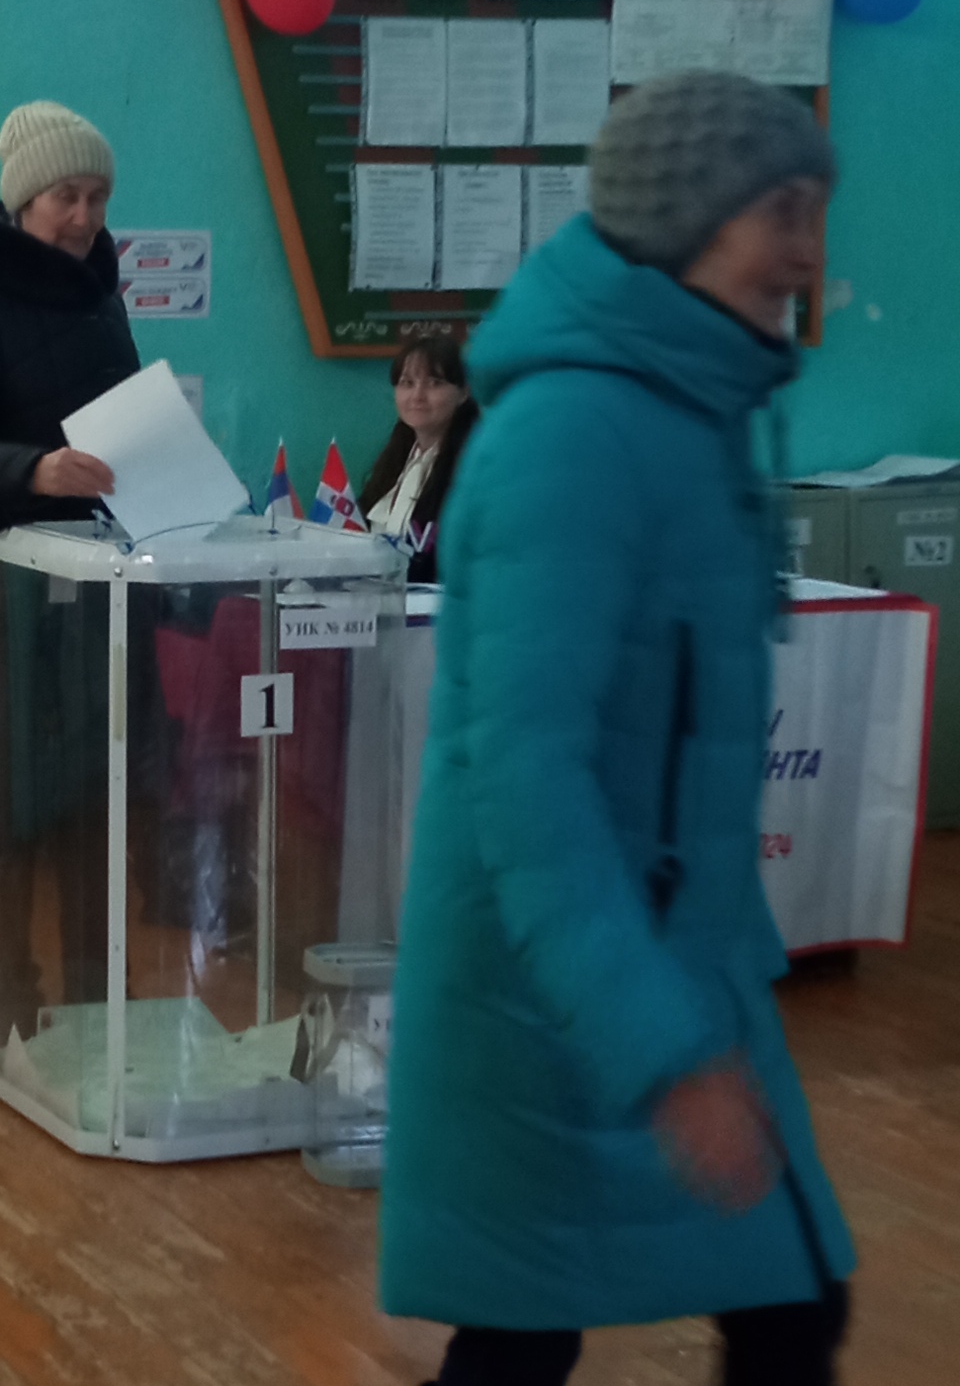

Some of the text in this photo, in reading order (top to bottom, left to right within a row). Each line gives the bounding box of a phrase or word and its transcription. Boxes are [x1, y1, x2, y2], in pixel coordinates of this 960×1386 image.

[284, 621, 320, 637] УИК
[343, 619, 375, 635] 4814
[259, 683, 279, 729] 1
